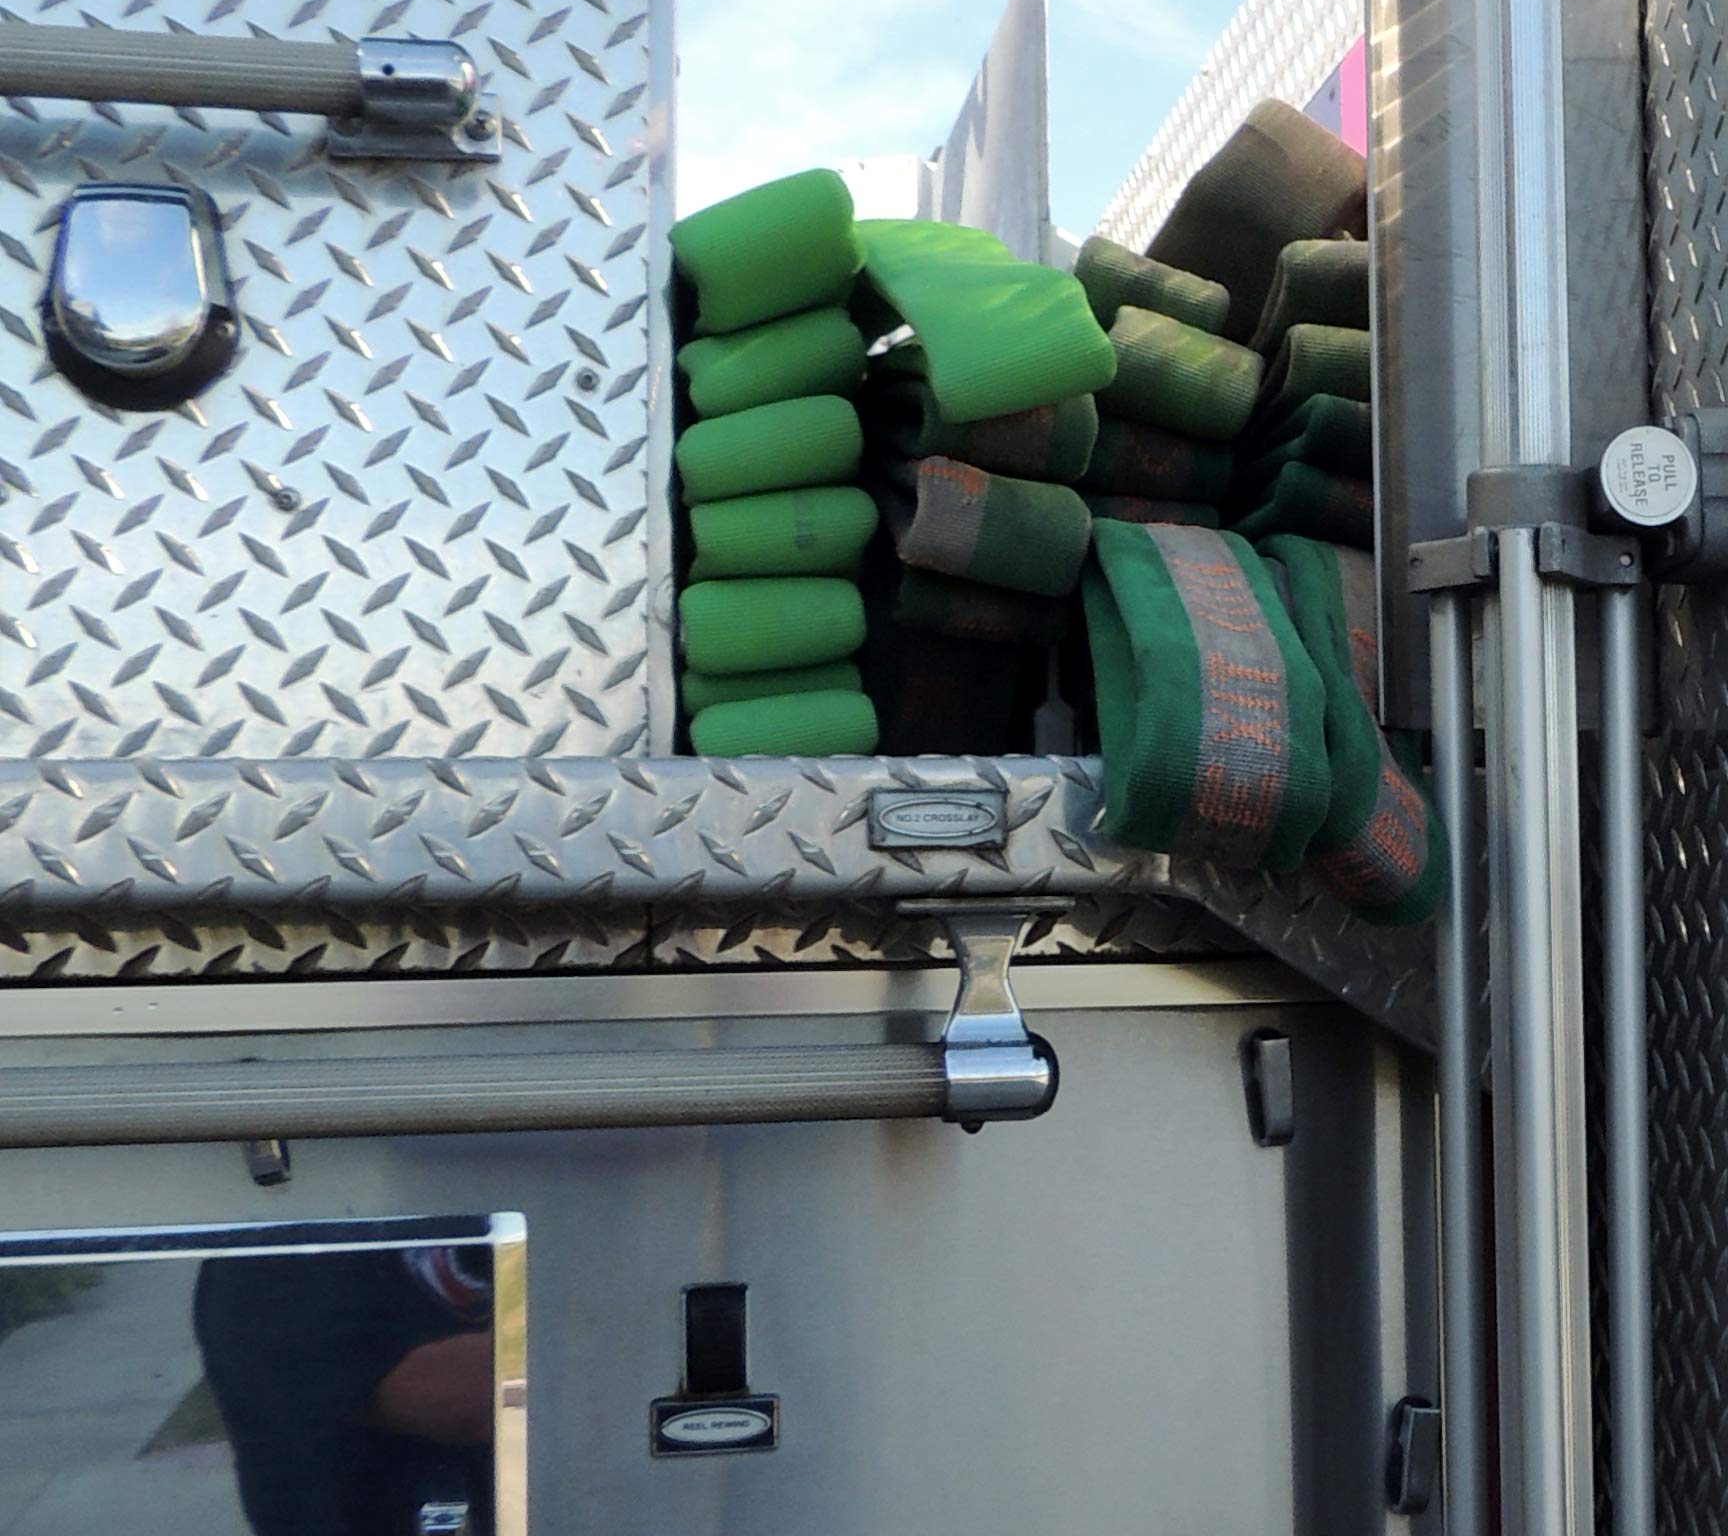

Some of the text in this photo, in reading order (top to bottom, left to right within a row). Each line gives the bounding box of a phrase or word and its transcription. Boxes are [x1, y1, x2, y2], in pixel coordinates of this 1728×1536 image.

[1629, 442, 1648, 506] RELEASE
[1648, 464, 1661, 483] TO
[1662, 454, 1678, 491] PULL
[922, 812, 981, 823] CROSSLAY
[682, 1419, 749, 1430] REEL REWIND
